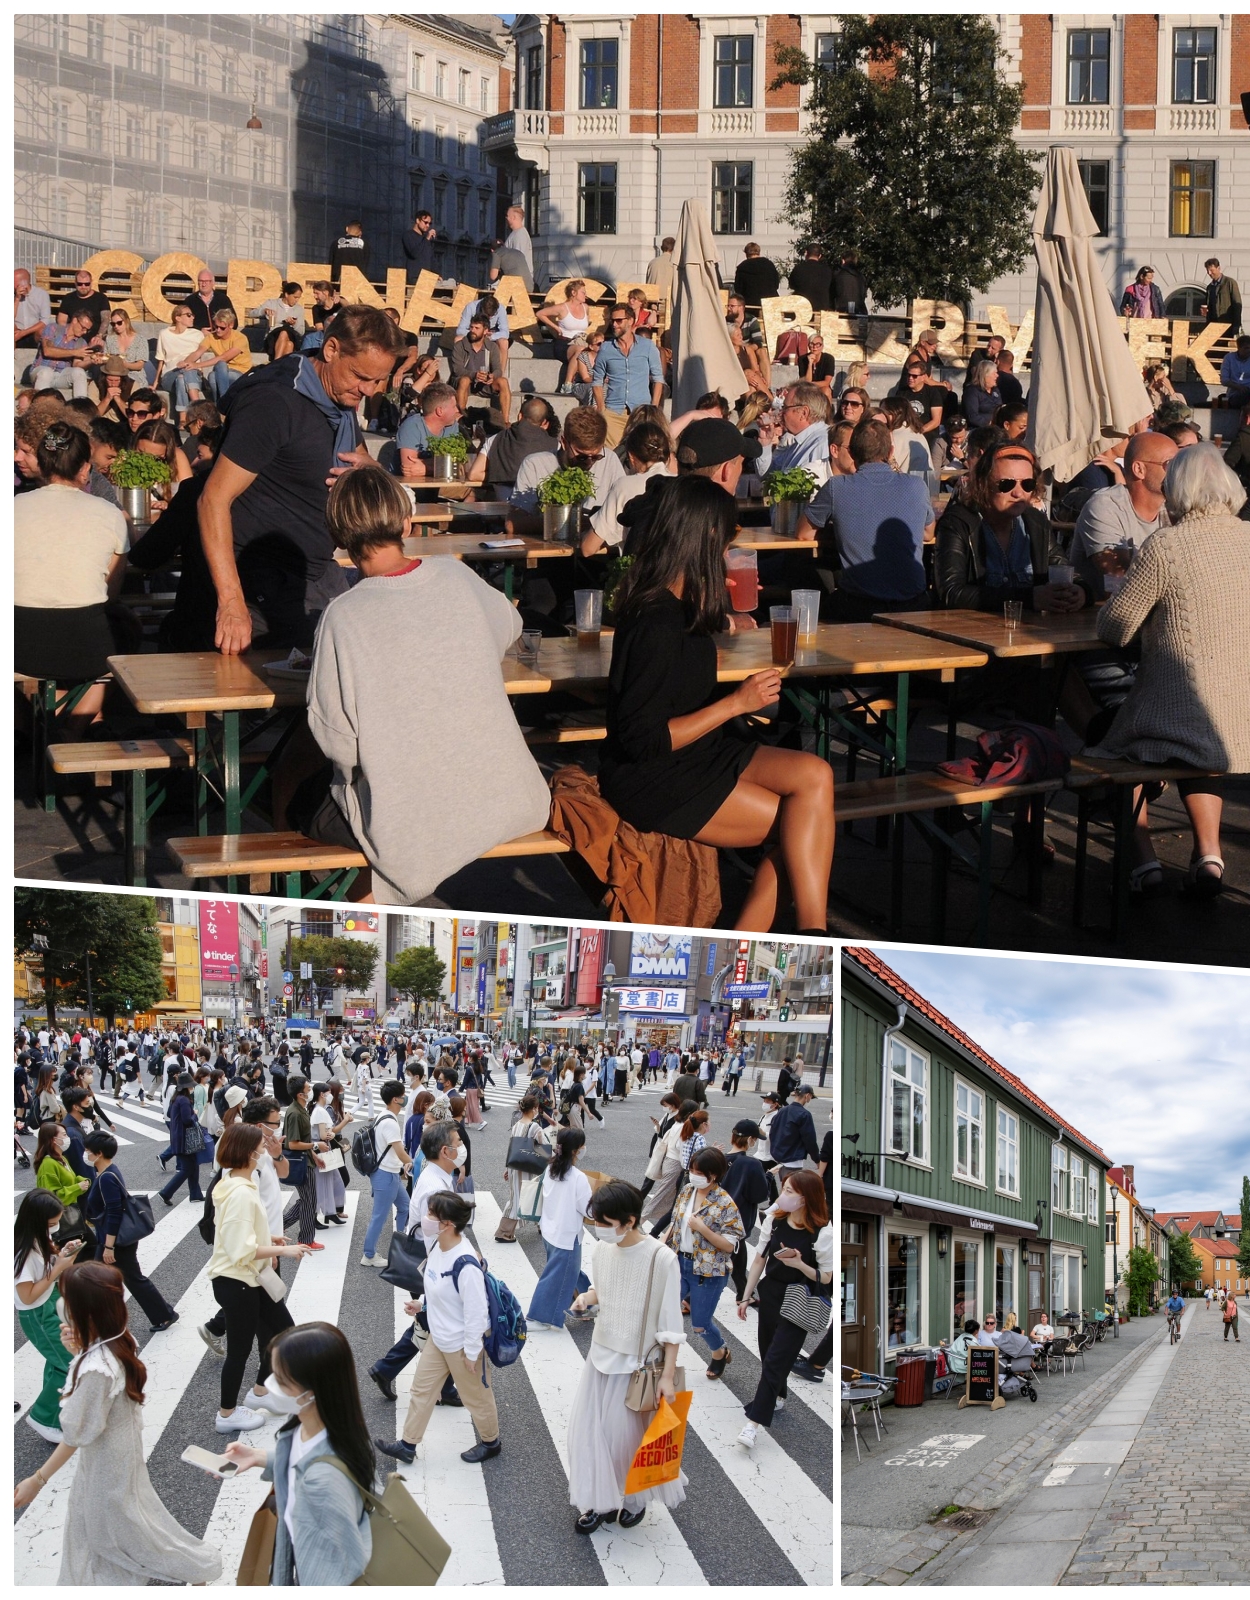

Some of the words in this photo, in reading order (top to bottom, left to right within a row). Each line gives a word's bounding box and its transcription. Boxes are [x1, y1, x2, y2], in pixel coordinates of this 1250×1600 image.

[80, 250, 730, 345] COPENHAGE
[211, 950, 235, 961] tinder
[631, 956, 687, 976] DMM
